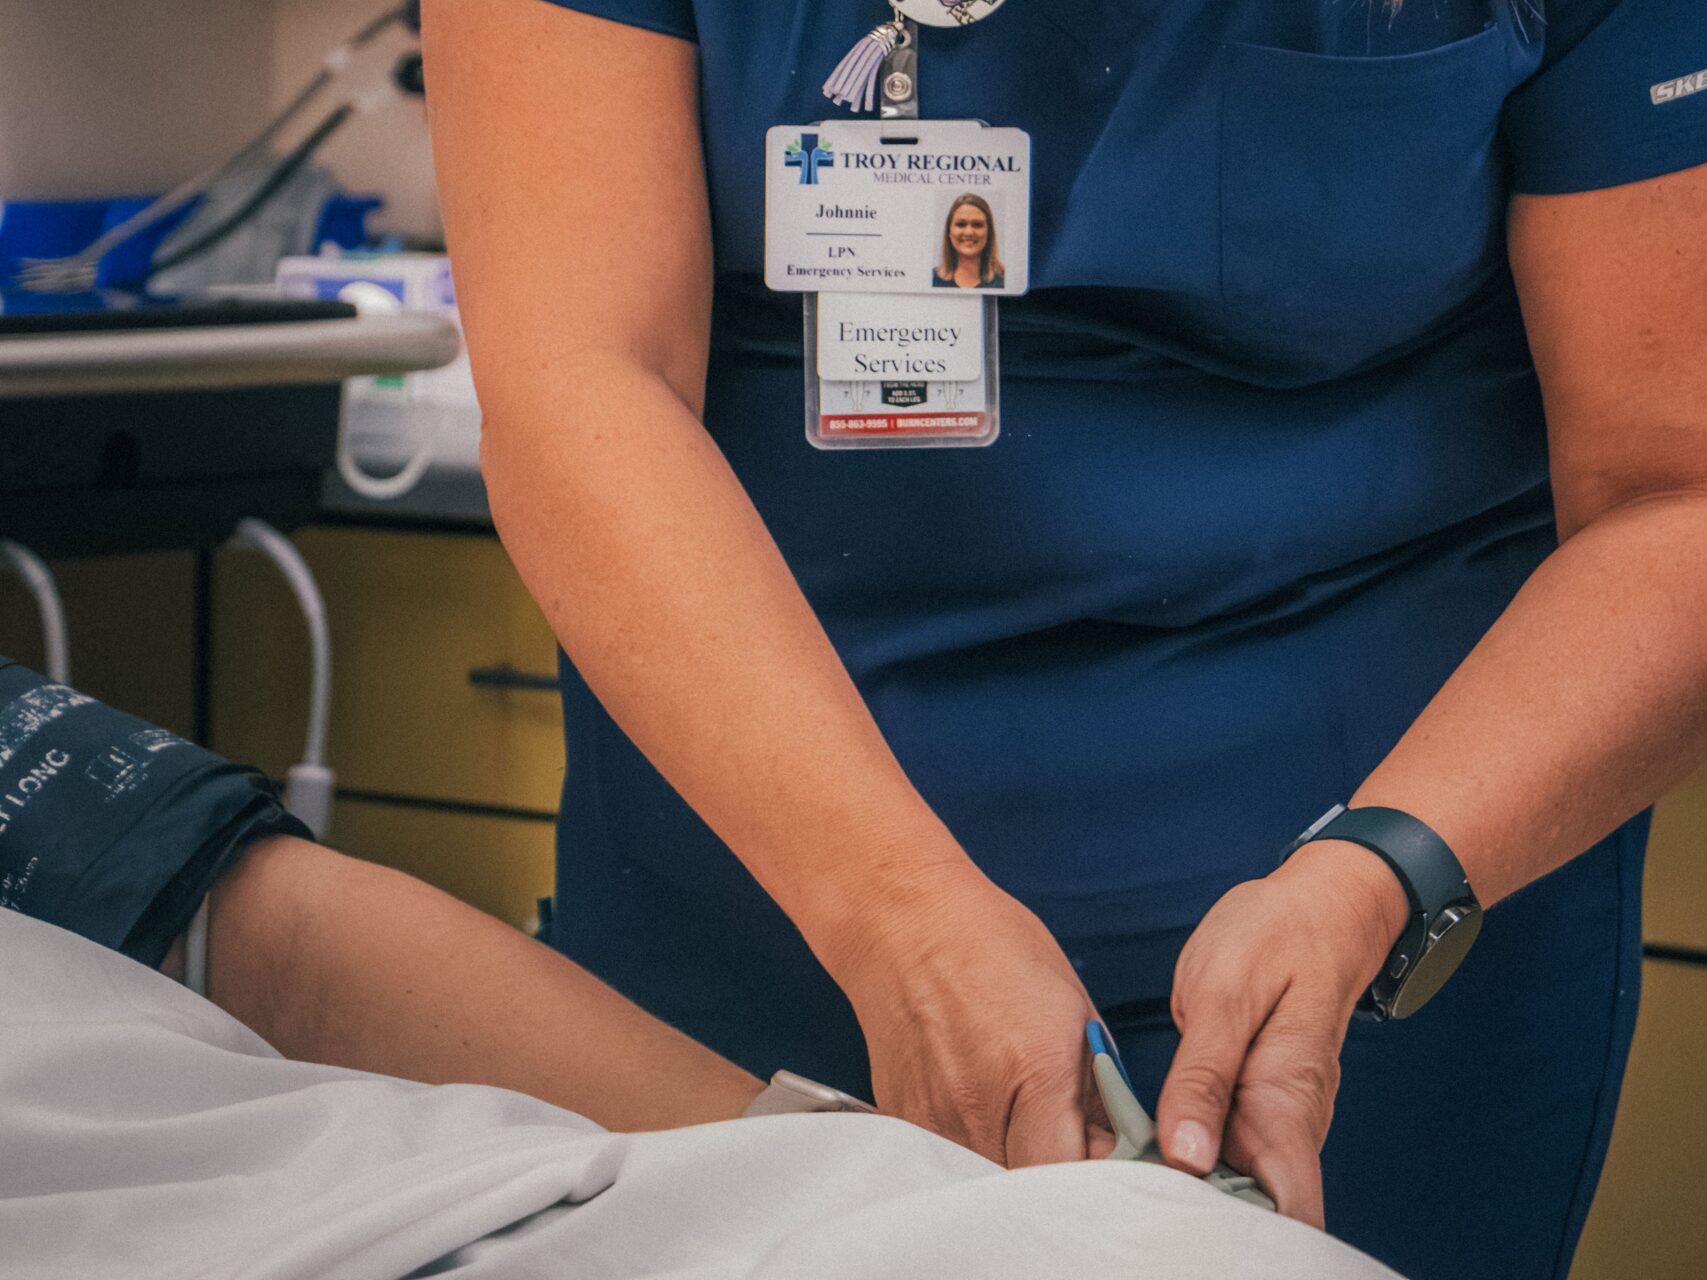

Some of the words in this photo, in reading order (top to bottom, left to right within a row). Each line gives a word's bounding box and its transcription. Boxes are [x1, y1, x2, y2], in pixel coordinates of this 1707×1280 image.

[840, 152, 901, 170] TROY
[907, 154, 1021, 173] REGIONAL
[873, 171, 934, 184] MEDICAL
[938, 172, 991, 185] CENTER
[815, 204, 877, 220] Johnnie
[828, 246, 856, 258] LPN
[787, 264, 852, 279] Emergency
[857, 265, 906, 278] Services
[839, 321, 962, 347] Emergency
[854, 353, 947, 374] Services
